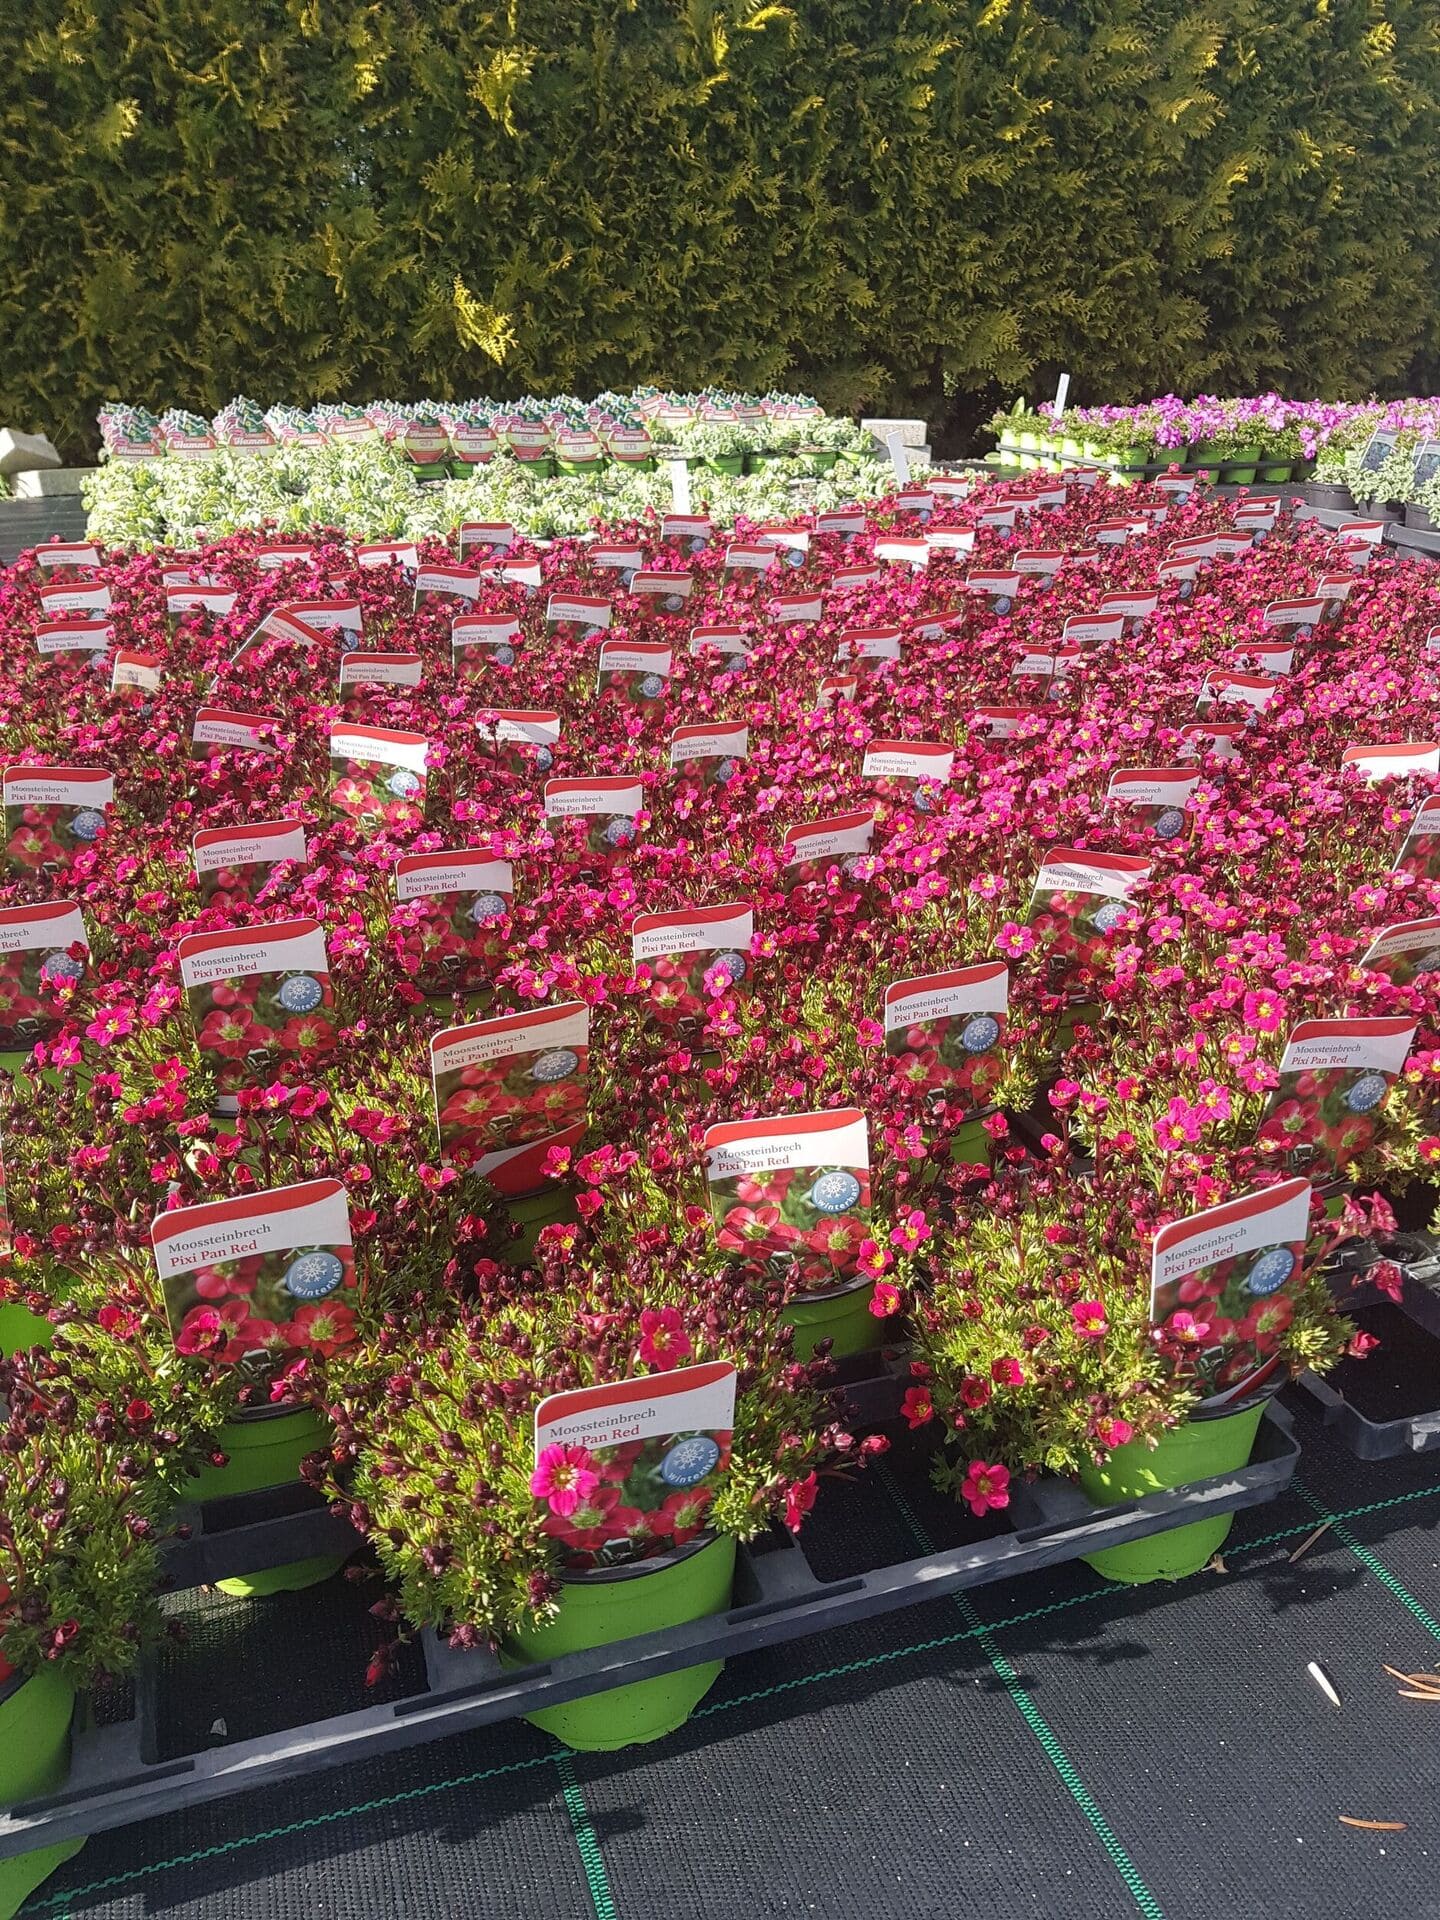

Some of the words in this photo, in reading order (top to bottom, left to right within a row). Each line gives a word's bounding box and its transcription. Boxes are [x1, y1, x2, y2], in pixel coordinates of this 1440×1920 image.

[214, 733, 227, 741] Pan
[228, 735, 242, 743] Red
[11, 793, 26, 801] Pixi
[44, 793, 61, 801] Red
[204, 858, 219, 866] Pixi
[221, 856, 237, 864] Pan
[238, 853, 254, 862] Red
[794, 852, 804, 860] ixi
[424, 884, 440, 892] Pan
[441, 881, 458, 890] Red
[2, 940, 21, 949] Red
[642, 944, 659, 953] Pixi
[661, 943, 677, 952] Pan
[679, 940, 696, 950] Red
[190, 950, 267, 968] Moossteinbrech
[192, 970, 213, 980] Pixi
[215, 966, 236, 977] Pan
[238, 962, 258, 973] Red
[894, 1014, 912, 1023] Pixi
[912, 1009, 929, 1019] Pan
[931, 1005, 950, 1015] Red
[444, 1056, 465, 1067] Pixi
[468, 1052, 488, 1063] Pan
[492, 1045, 514, 1056] Red
[1291, 1056, 1310, 1065] Pixi
[1311, 1057, 1327, 1065] Pan
[1329, 1055, 1348, 1064] Red
[717, 1142, 802, 1160] Moossteinbrech
[718, 1157, 740, 1172] Pixi
[743, 1156, 765, 1170] Pan
[768, 1155, 790, 1167] Red
[168, 1224, 271, 1254] Moossteinbrech
[1164, 1227, 1247, 1264] Moossteinbrech
[170, 1252, 198, 1268] Pixi
[201, 1248, 227, 1261] Pan
[230, 1240, 258, 1254] Red
[1162, 1262, 1185, 1278] Pixi
[1188, 1256, 1208, 1268] Pan
[1211, 1244, 1234, 1260] Red
[549, 1408, 657, 1438] Moossteinbrech
[582, 1430, 608, 1446] Pan
[612, 1424, 640, 1440] Red
